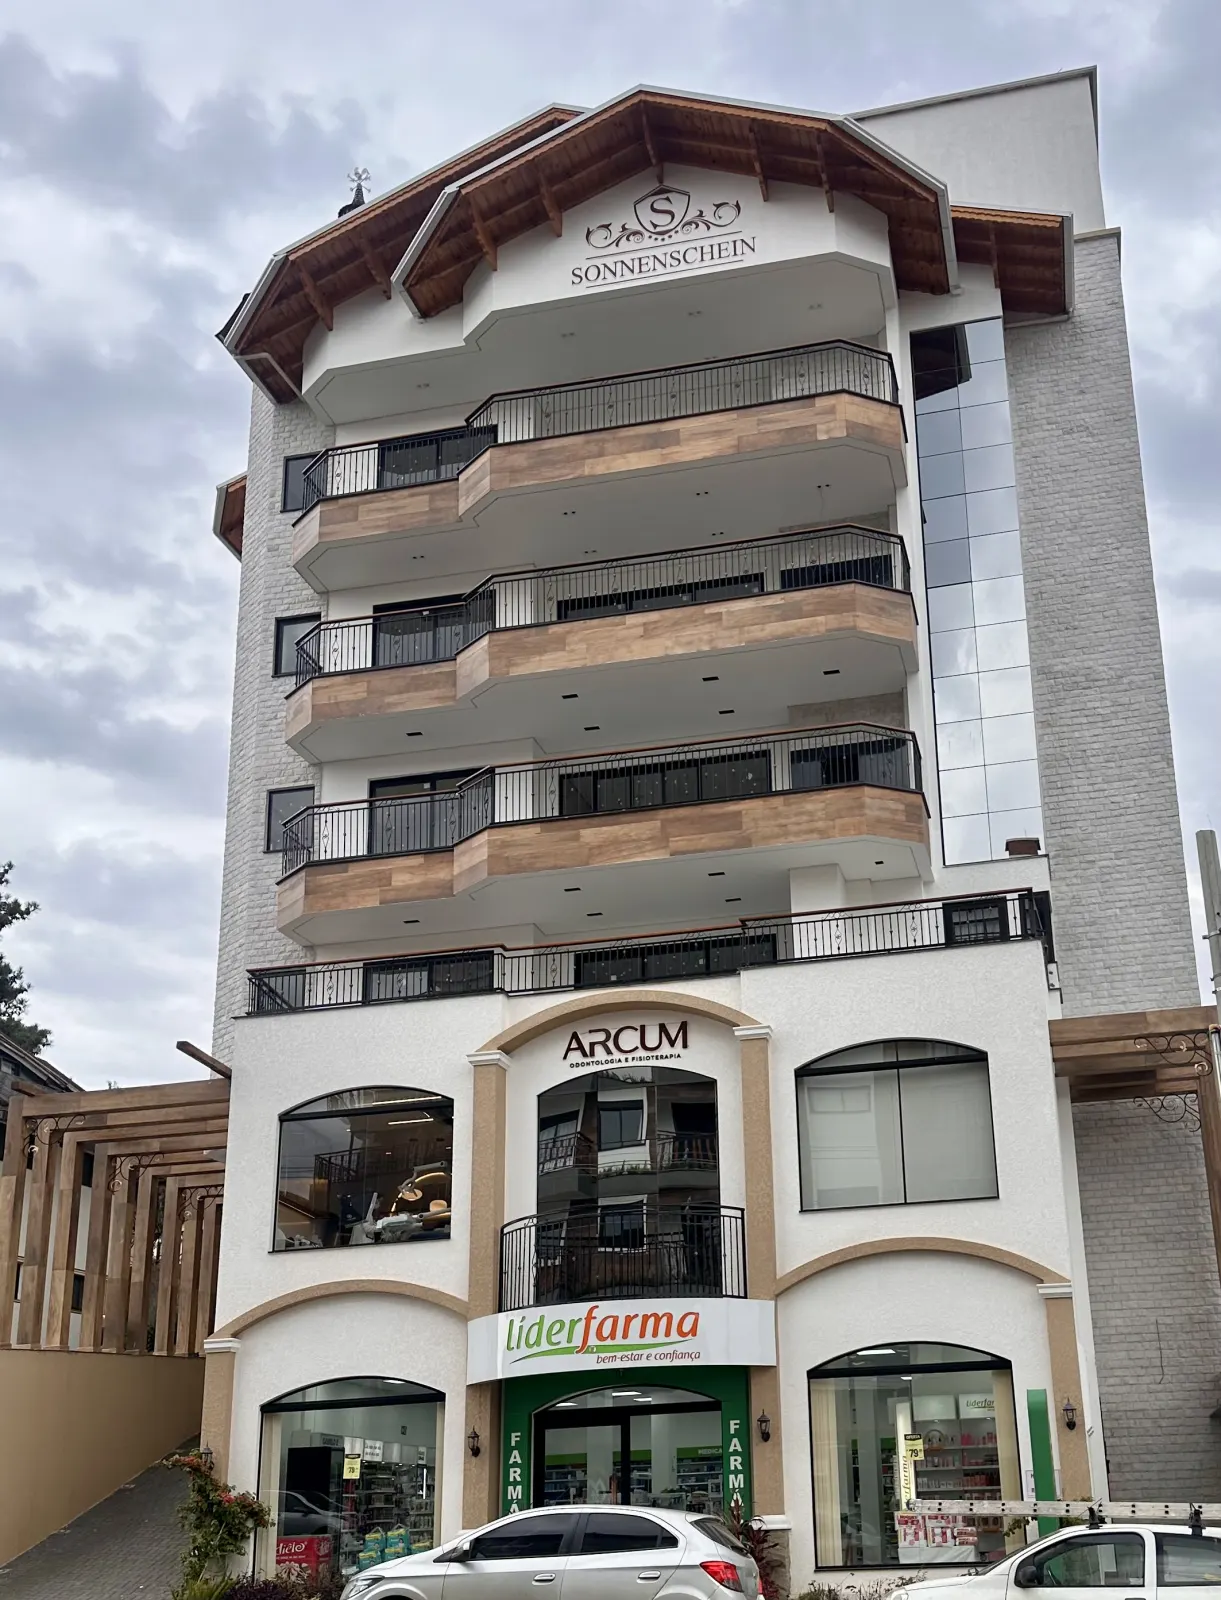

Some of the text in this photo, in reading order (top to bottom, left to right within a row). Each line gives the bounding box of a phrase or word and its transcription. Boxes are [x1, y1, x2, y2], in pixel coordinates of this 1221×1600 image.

[649, 196, 675, 229] S
[571, 236, 756, 285] SONNENSCHEIN
[562, 1020, 688, 1060] ARCUM
[569, 1058, 622, 1069] ODONTOLOGIA
[631, 1053, 682, 1062] FISIOTERAPIA
[506, 1305, 700, 1354] líderfarma
[596, 1350, 701, 1364] bem-estar e confiança
[908, 1448, 919, 1458] 79
